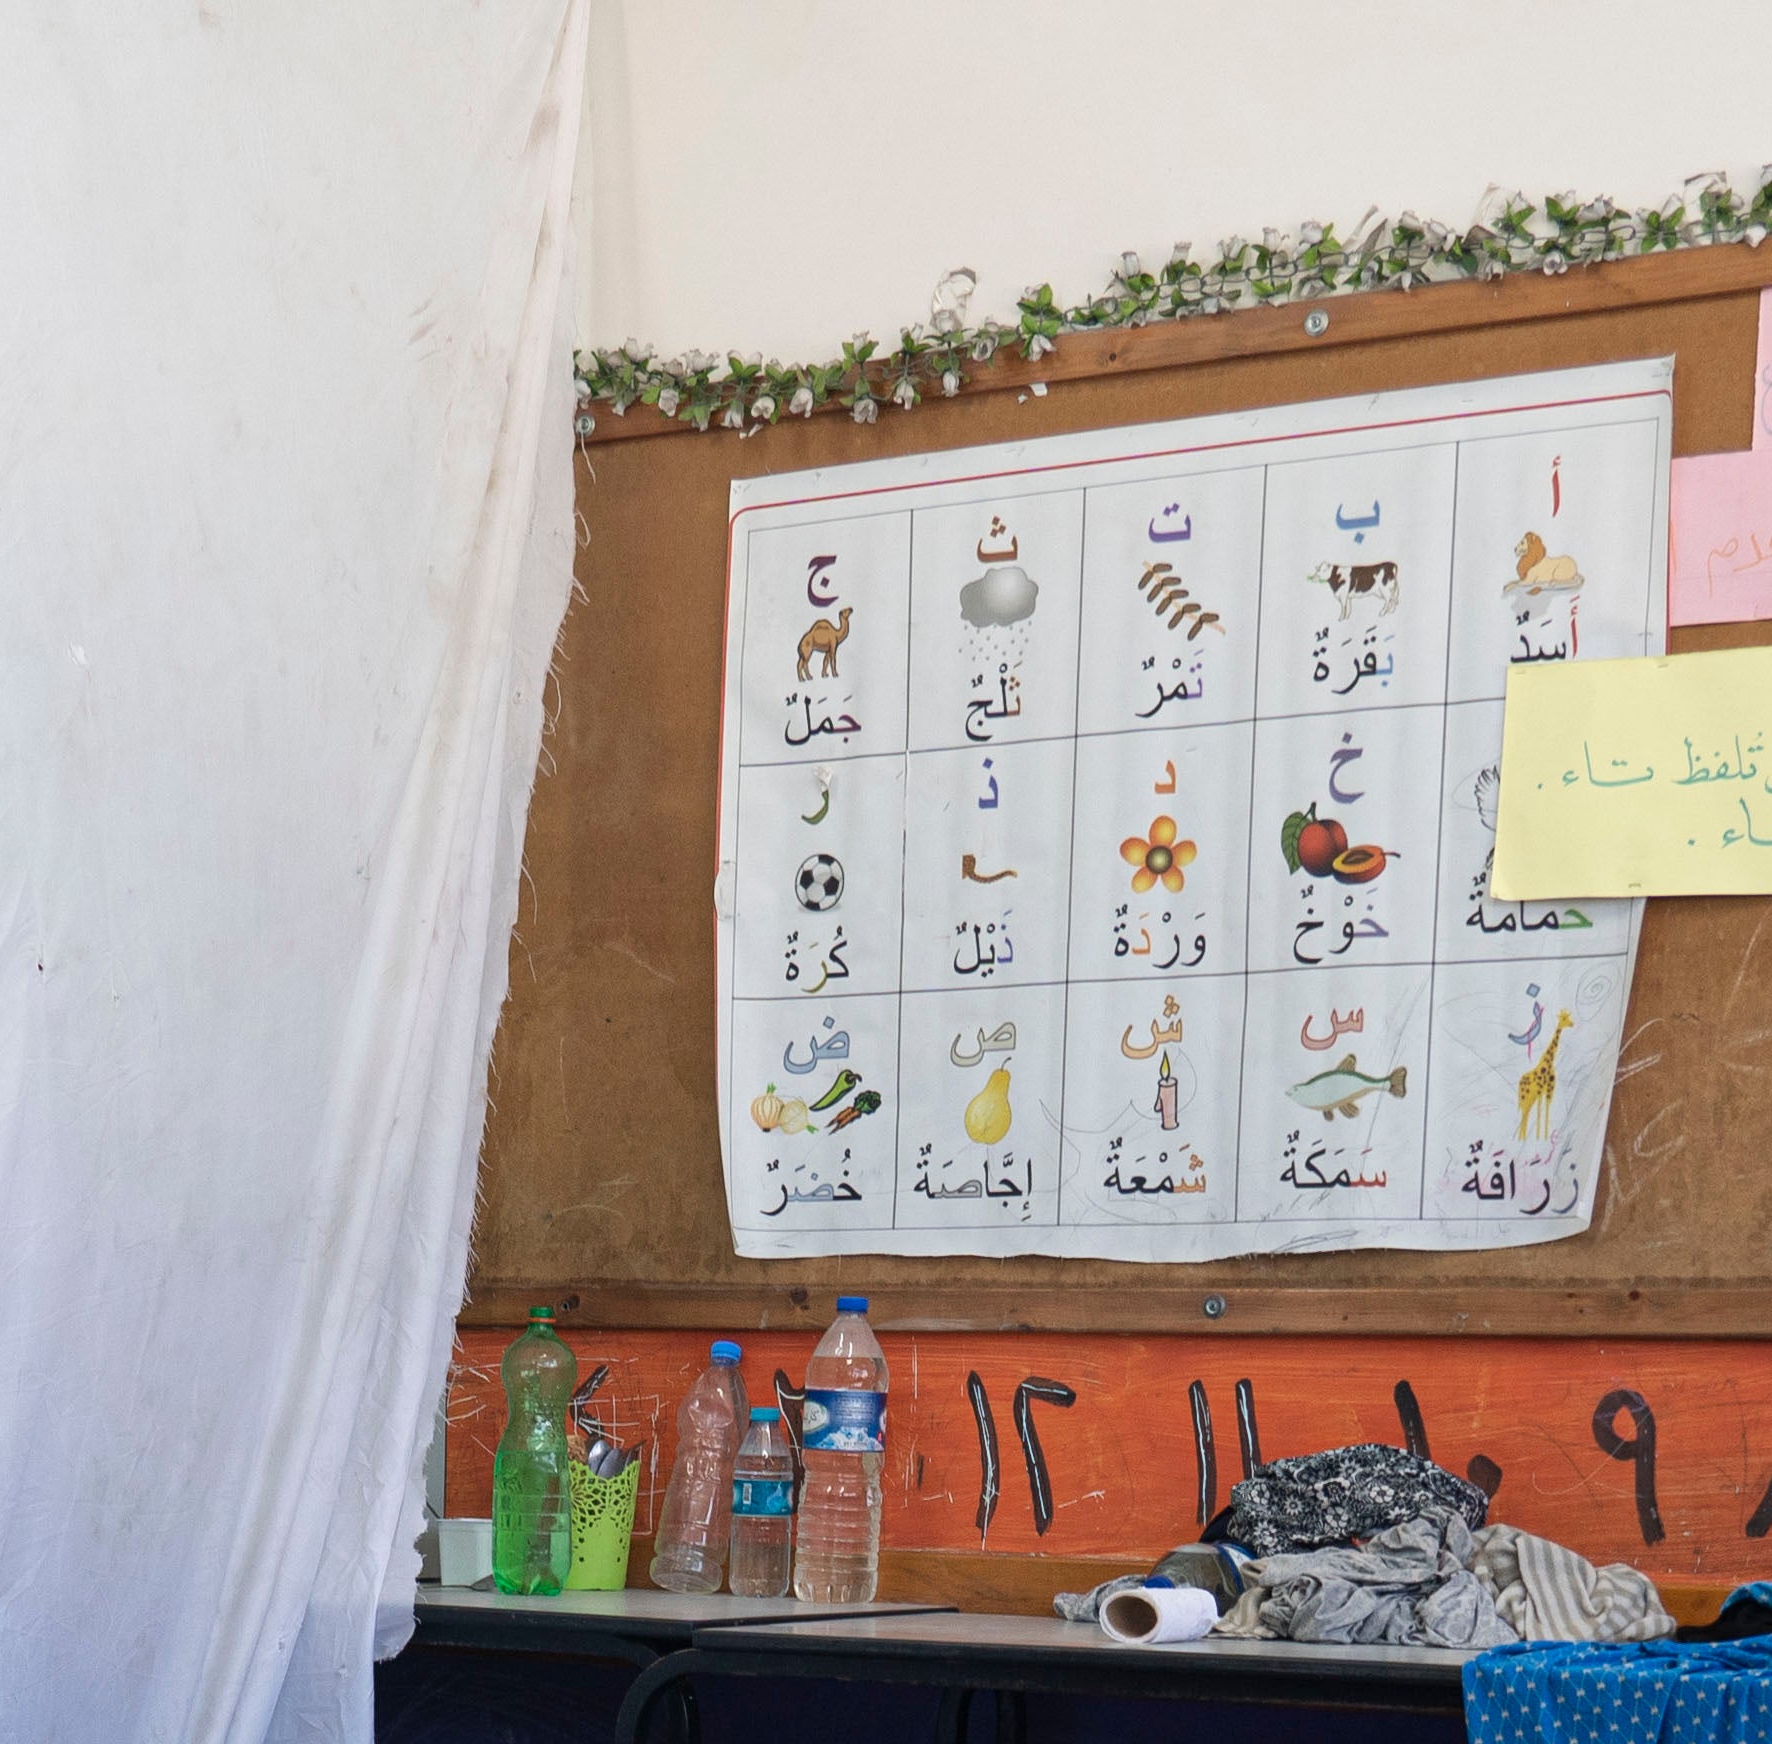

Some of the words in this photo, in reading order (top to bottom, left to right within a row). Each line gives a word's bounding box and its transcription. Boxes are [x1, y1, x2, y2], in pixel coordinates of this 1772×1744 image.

[977, 516, 1018, 563] ث
[1148, 502, 1191, 543] ت
[1335, 499, 1381, 544] ب
[807, 555, 839, 607] ج
[978, 759, 999, 809] ذ
[1155, 761, 1177, 794] د
[1329, 733, 1365, 804] خ
[1121, 995, 1183, 1059] ش
[1301, 1006, 1364, 1050] س
[1508, 983, 1542, 1045] ز
[783, 1016, 850, 1075] ض
[950, 1021, 1016, 1067] ص
